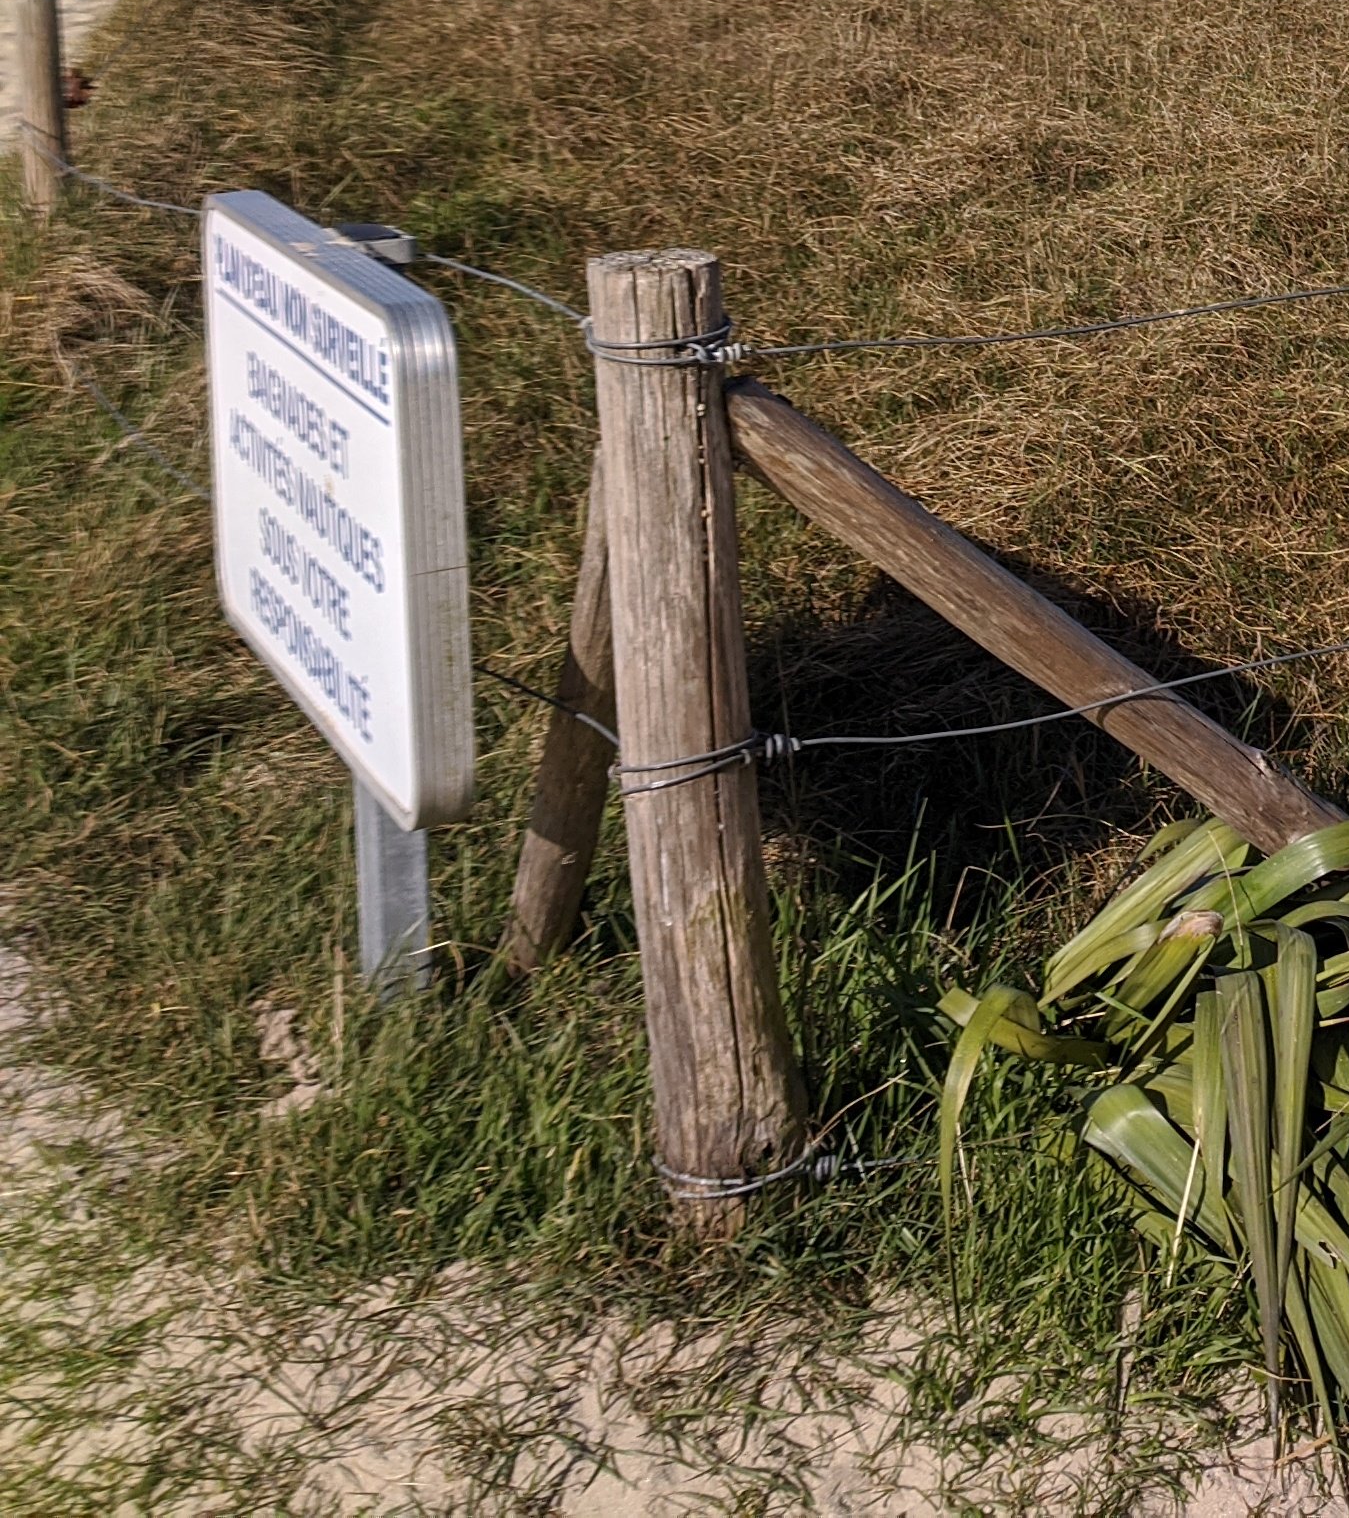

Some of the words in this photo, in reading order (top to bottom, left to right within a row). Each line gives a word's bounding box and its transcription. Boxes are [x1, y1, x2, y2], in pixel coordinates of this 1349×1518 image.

[281, 281, 310, 346] NON
[246, 350, 328, 461] BAIGNADES
[329, 418, 350, 480] ET
[229, 407, 297, 507] ACTIVITÉS
[296, 466, 386, 594] NAUTIQUES
[258, 506, 300, 586] SOUS
[300, 545, 352, 642] VOTRE
